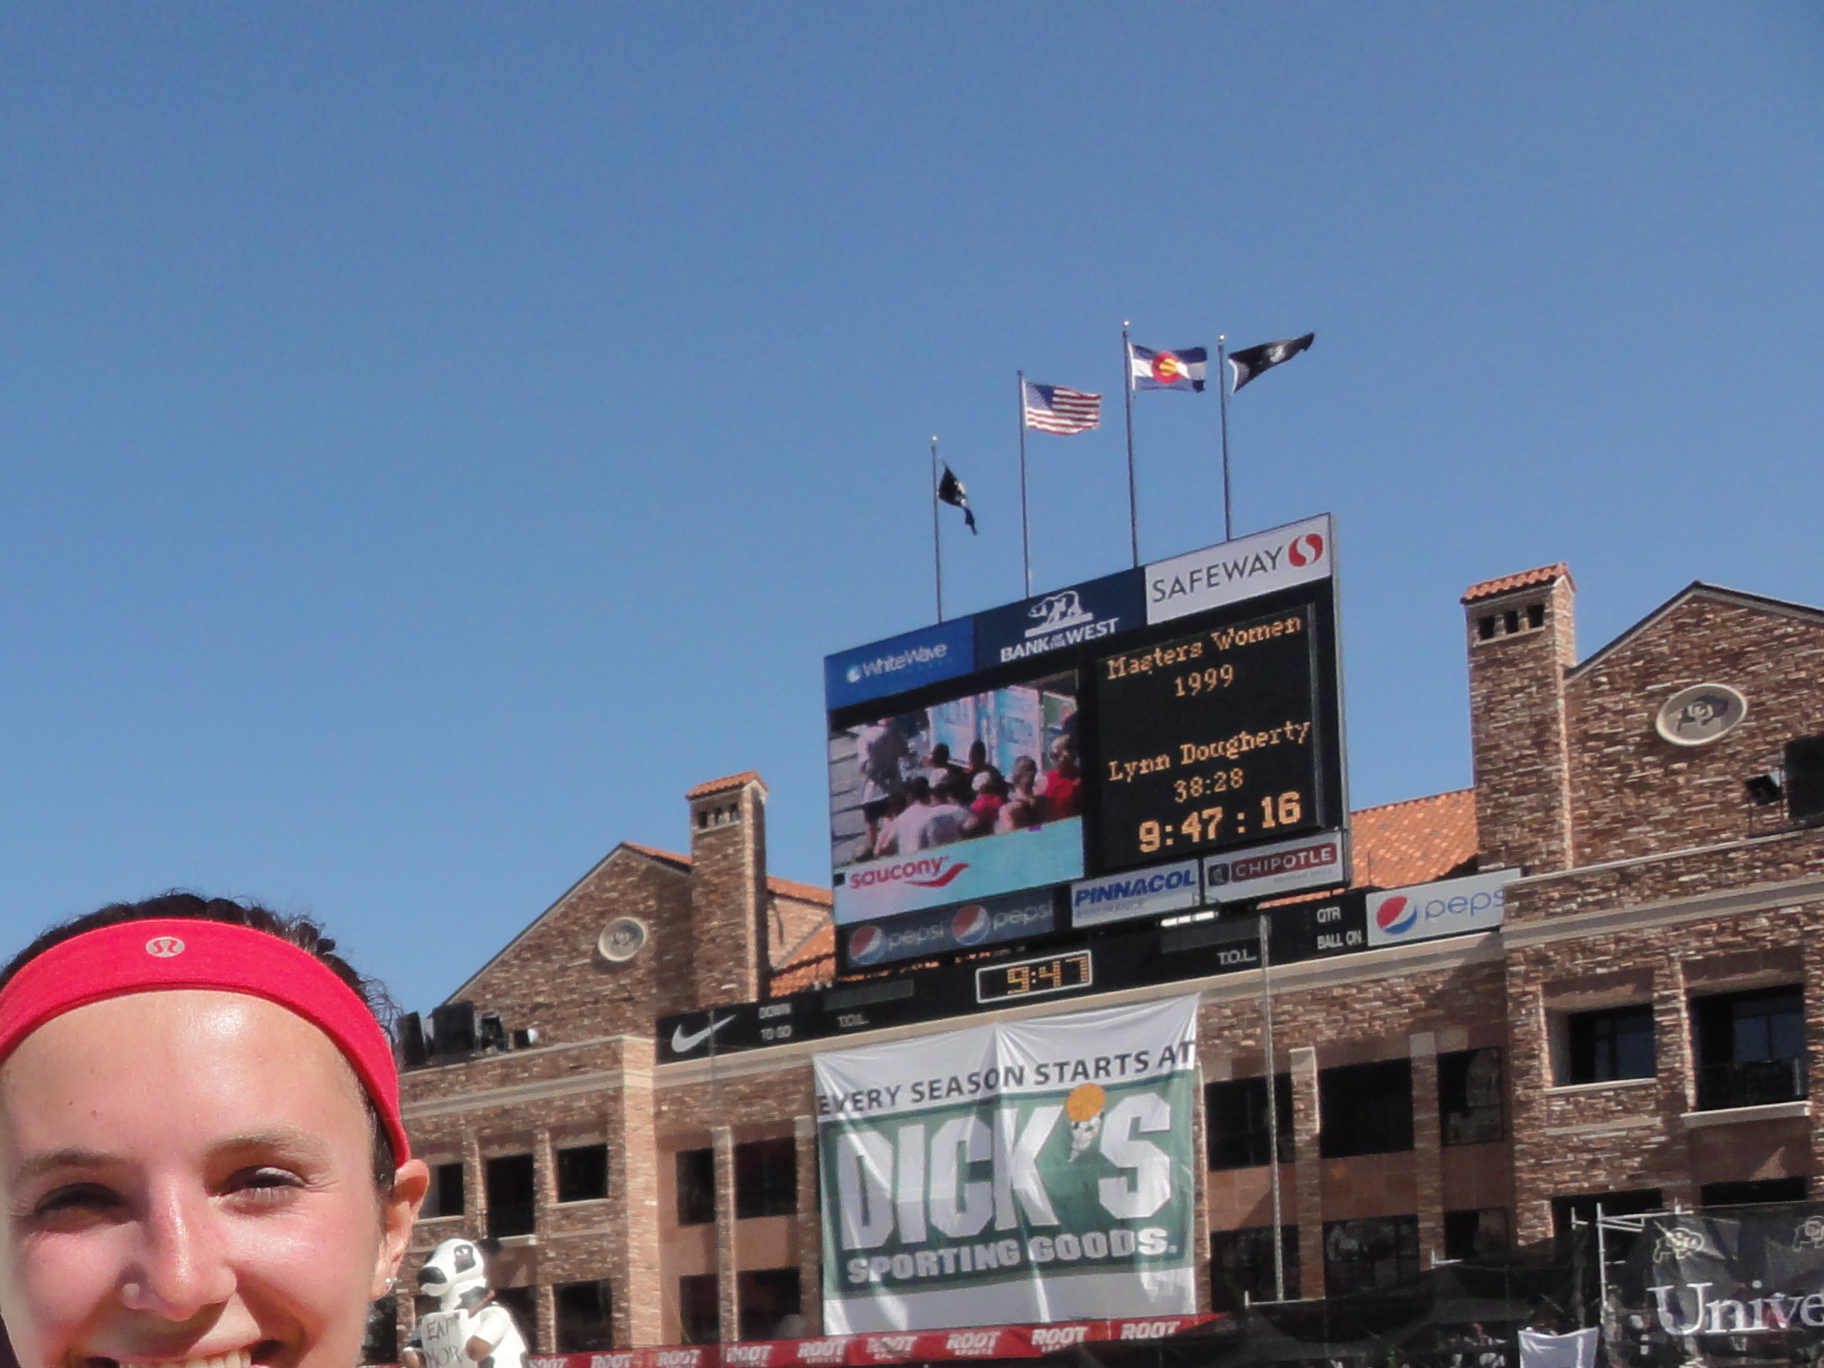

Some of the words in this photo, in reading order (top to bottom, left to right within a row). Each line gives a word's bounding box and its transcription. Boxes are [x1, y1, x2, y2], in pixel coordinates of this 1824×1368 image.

[1152, 546, 1283, 603] SAFEWAY
[1000, 636, 1051, 664] BANK
[1065, 617, 1120, 645] WEST
[1106, 641, 1204, 680] Masters
[1210, 616, 1302, 652] Women
[861, 642, 949, 678] WhiteWave
[1175, 664, 1234, 697] 1999
[1108, 754, 1171, 783] Lynn
[1180, 720, 1311, 765] Dougherty
[1174, 768, 1245, 803] 38:28
[849, 856, 945, 890] saucony
[1235, 847, 1333, 878] CHIPOTLE
[1074, 869, 1196, 907] PINNACOL
[1424, 887, 1505, 920] peps
[992, 899, 1053, 931] pepsi
[887, 921, 946, 951] pepsi
[1317, 933, 1344, 950] BALL
[1346, 930, 1363, 946] ON
[1006, 956, 1089, 996] 9:47
[818, 1083, 903, 1117] EVERY
[910, 1063, 1026, 1104] SEASON
[1034, 1049, 1150, 1085] STARTS
[1156, 1038, 1197, 1068] AT
[835, 1090, 1173, 1251] DICK'S
[847, 1240, 1021, 1285] SPORTING
[945, 1331, 1001, 1350] ROOT
[1030, 1326, 1089, 1346] ROOT
[1120, 1321, 1181, 1340] ROOT
[657, 1349, 702, 1367] ROOT
[797, 1339, 848, 1358] ROOT
